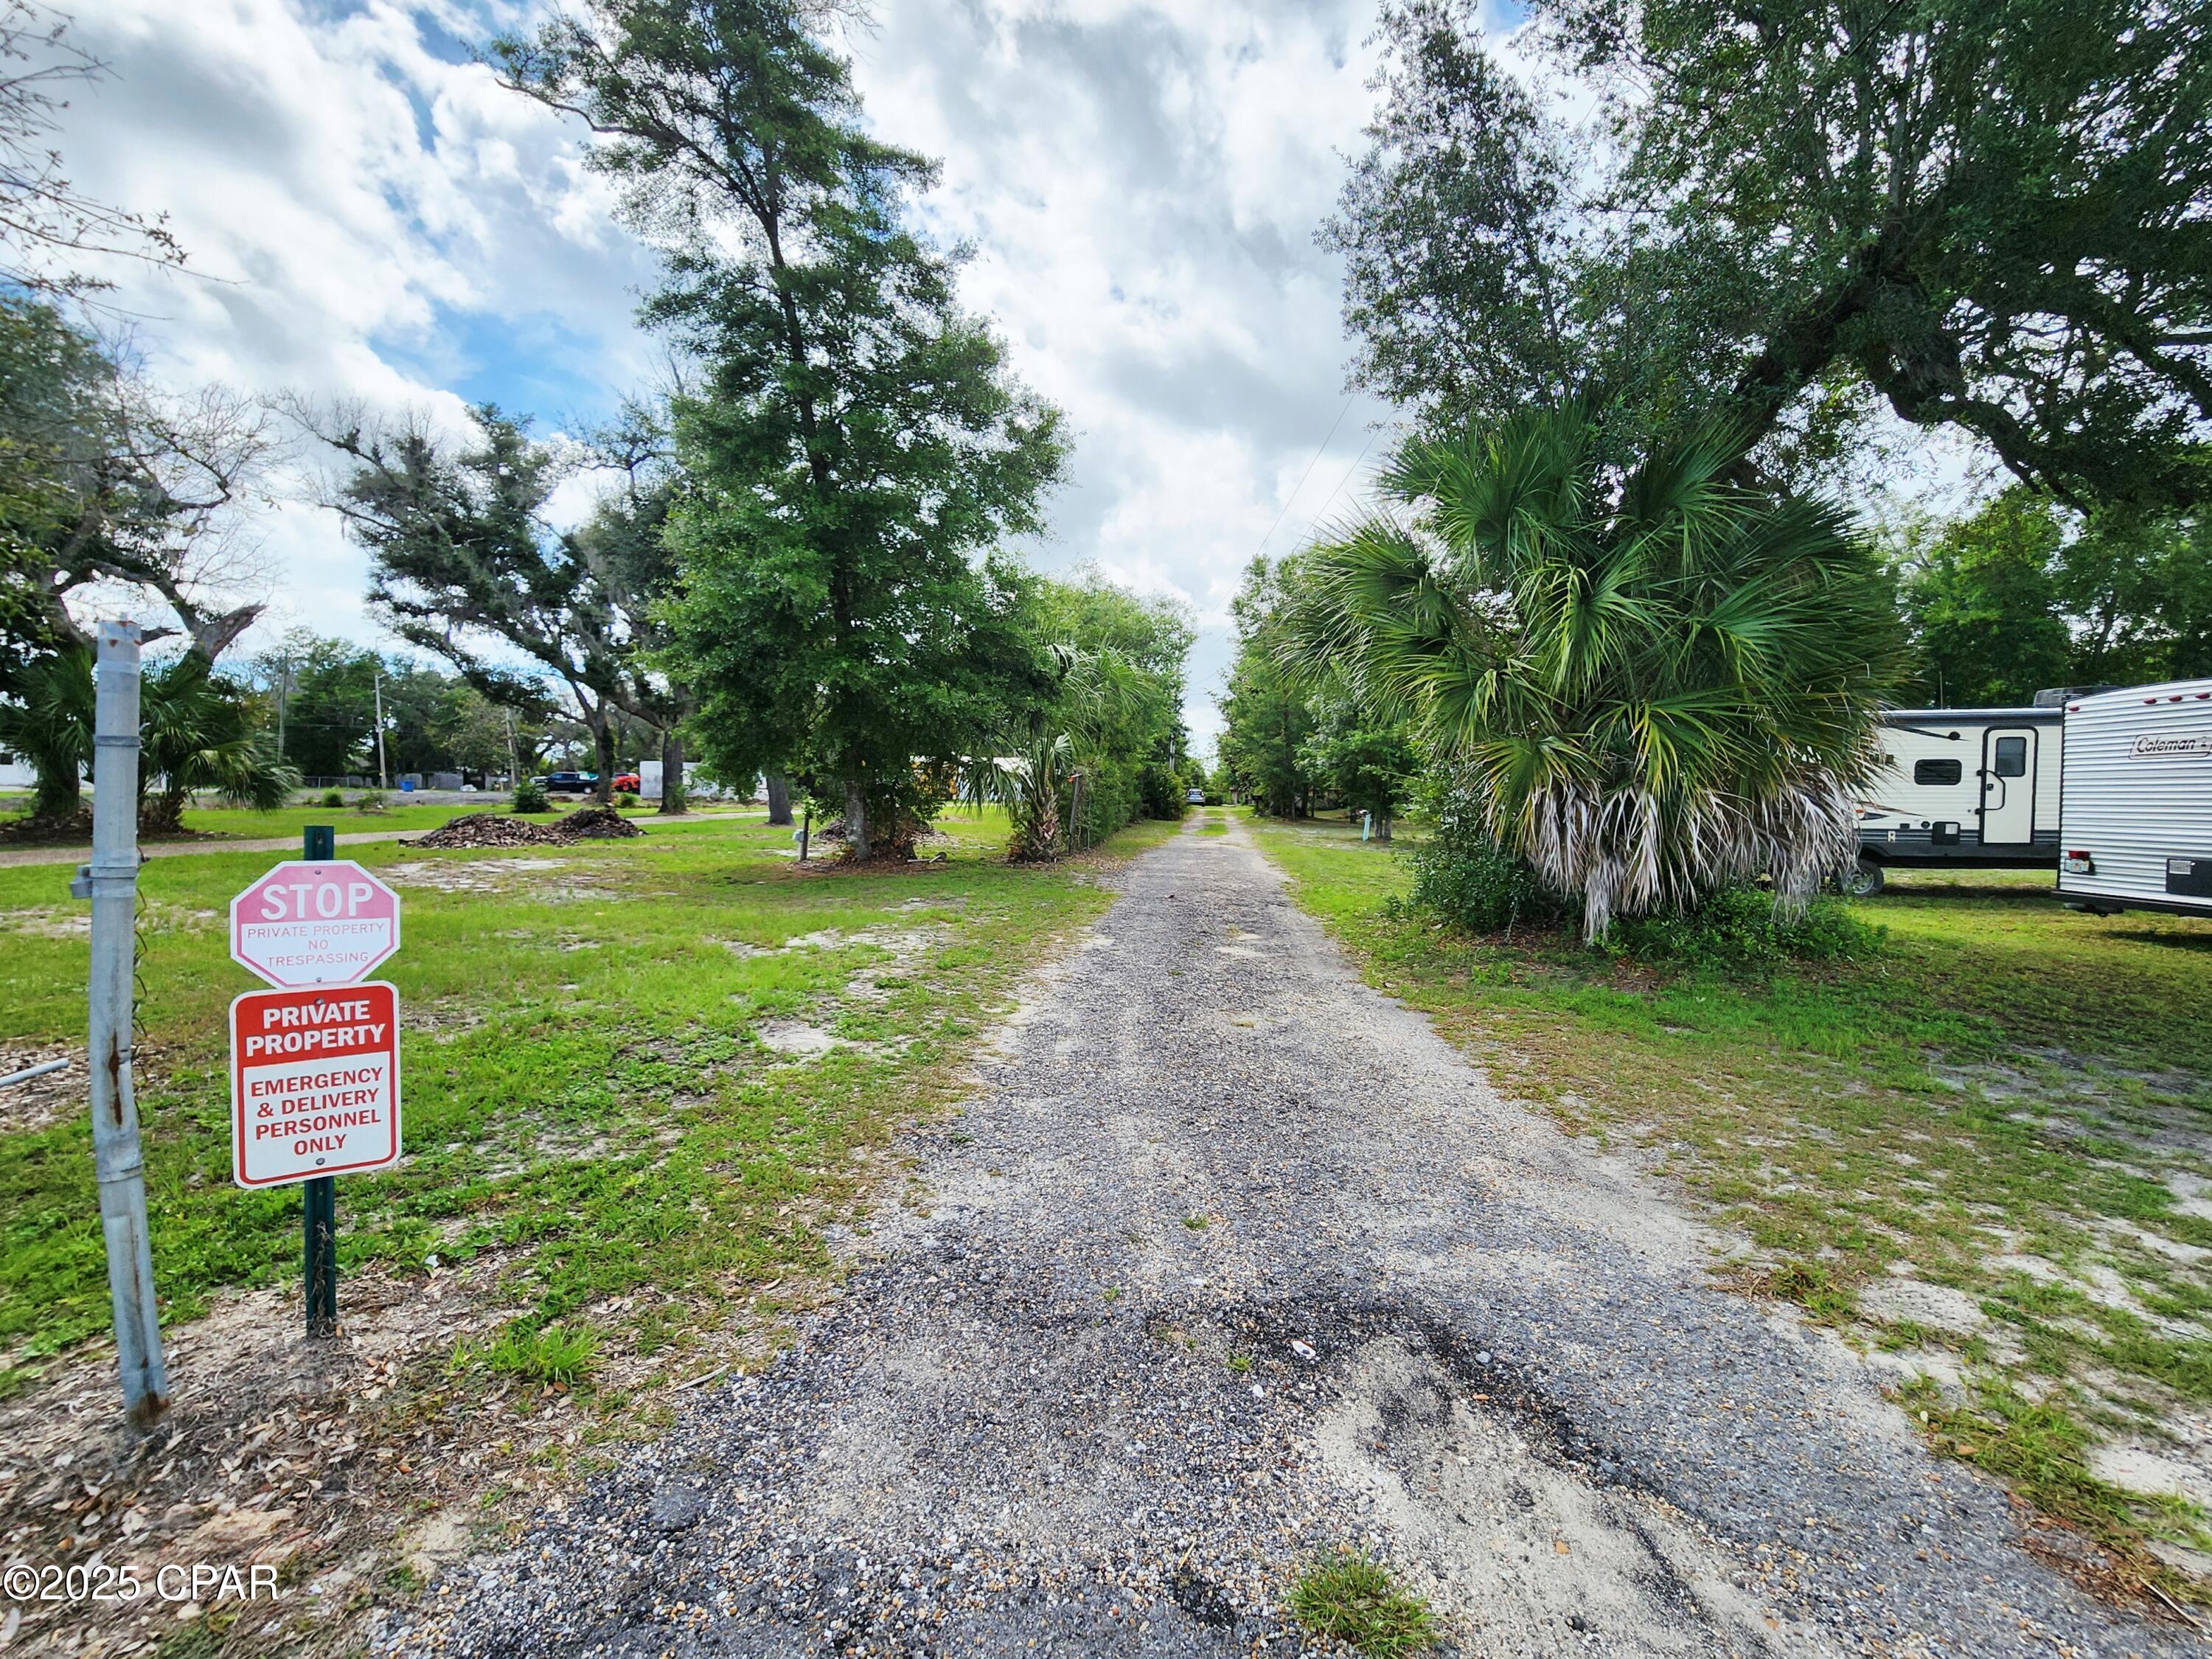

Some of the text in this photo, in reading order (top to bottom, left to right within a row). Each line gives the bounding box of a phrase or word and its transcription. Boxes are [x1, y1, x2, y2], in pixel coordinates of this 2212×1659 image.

[2137, 737, 2196, 752] Coleman
[260, 883, 373, 920] STOP
[248, 923, 385, 939] PRIVATE PROPERTY
[308, 940, 329, 950] NO
[268, 952, 369, 967] TRESPASSING
[262, 1000, 370, 1029] PRIVATE
[246, 1023, 386, 1057] PROPERTY
[251, 1067, 383, 1097] EMERGENCY
[257, 1088, 380, 1119] & DELIVERY
[256, 1110, 381, 1140] PERSONNEL
[294, 1134, 347, 1155] ONLY
